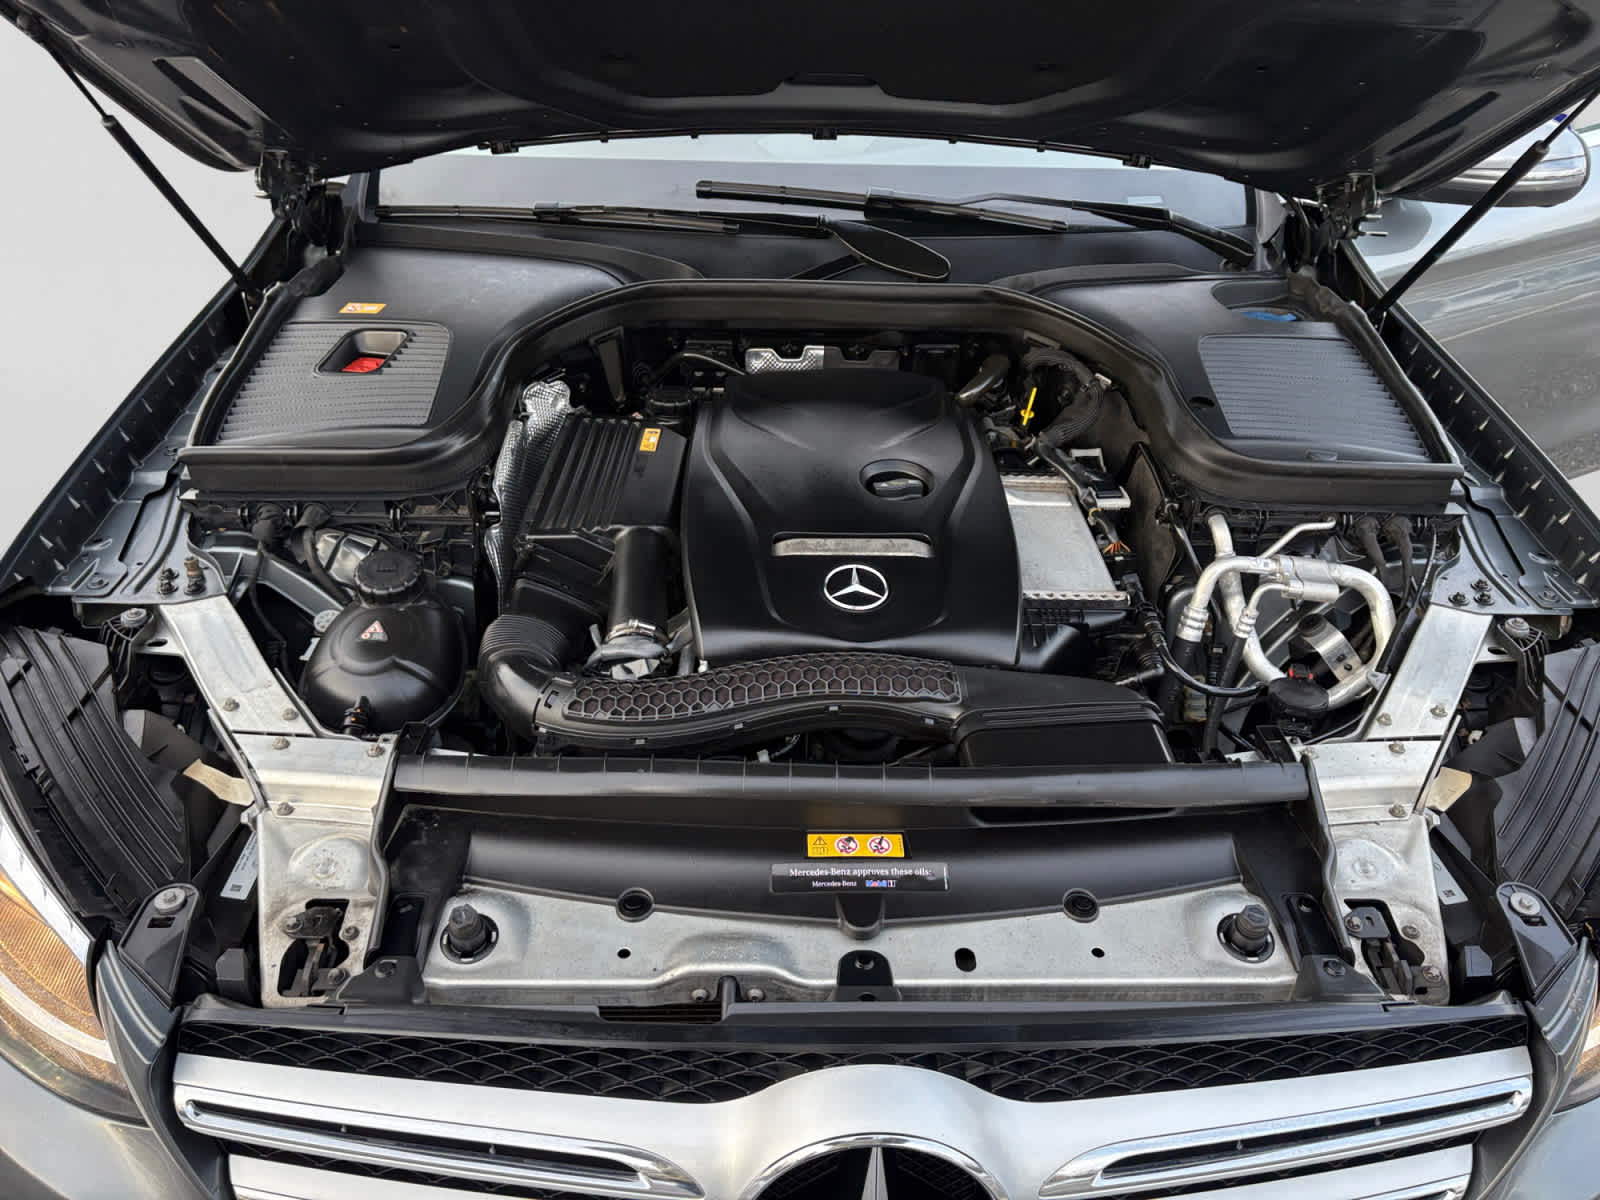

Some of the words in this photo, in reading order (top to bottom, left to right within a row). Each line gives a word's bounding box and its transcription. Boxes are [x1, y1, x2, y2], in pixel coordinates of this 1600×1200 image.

[789, 867, 850, 877] Mercedes-Benz
[852, 868, 888, 878] approves
[890, 866, 913, 876] these
[811, 880, 857, 888] Mercedes-Benz
